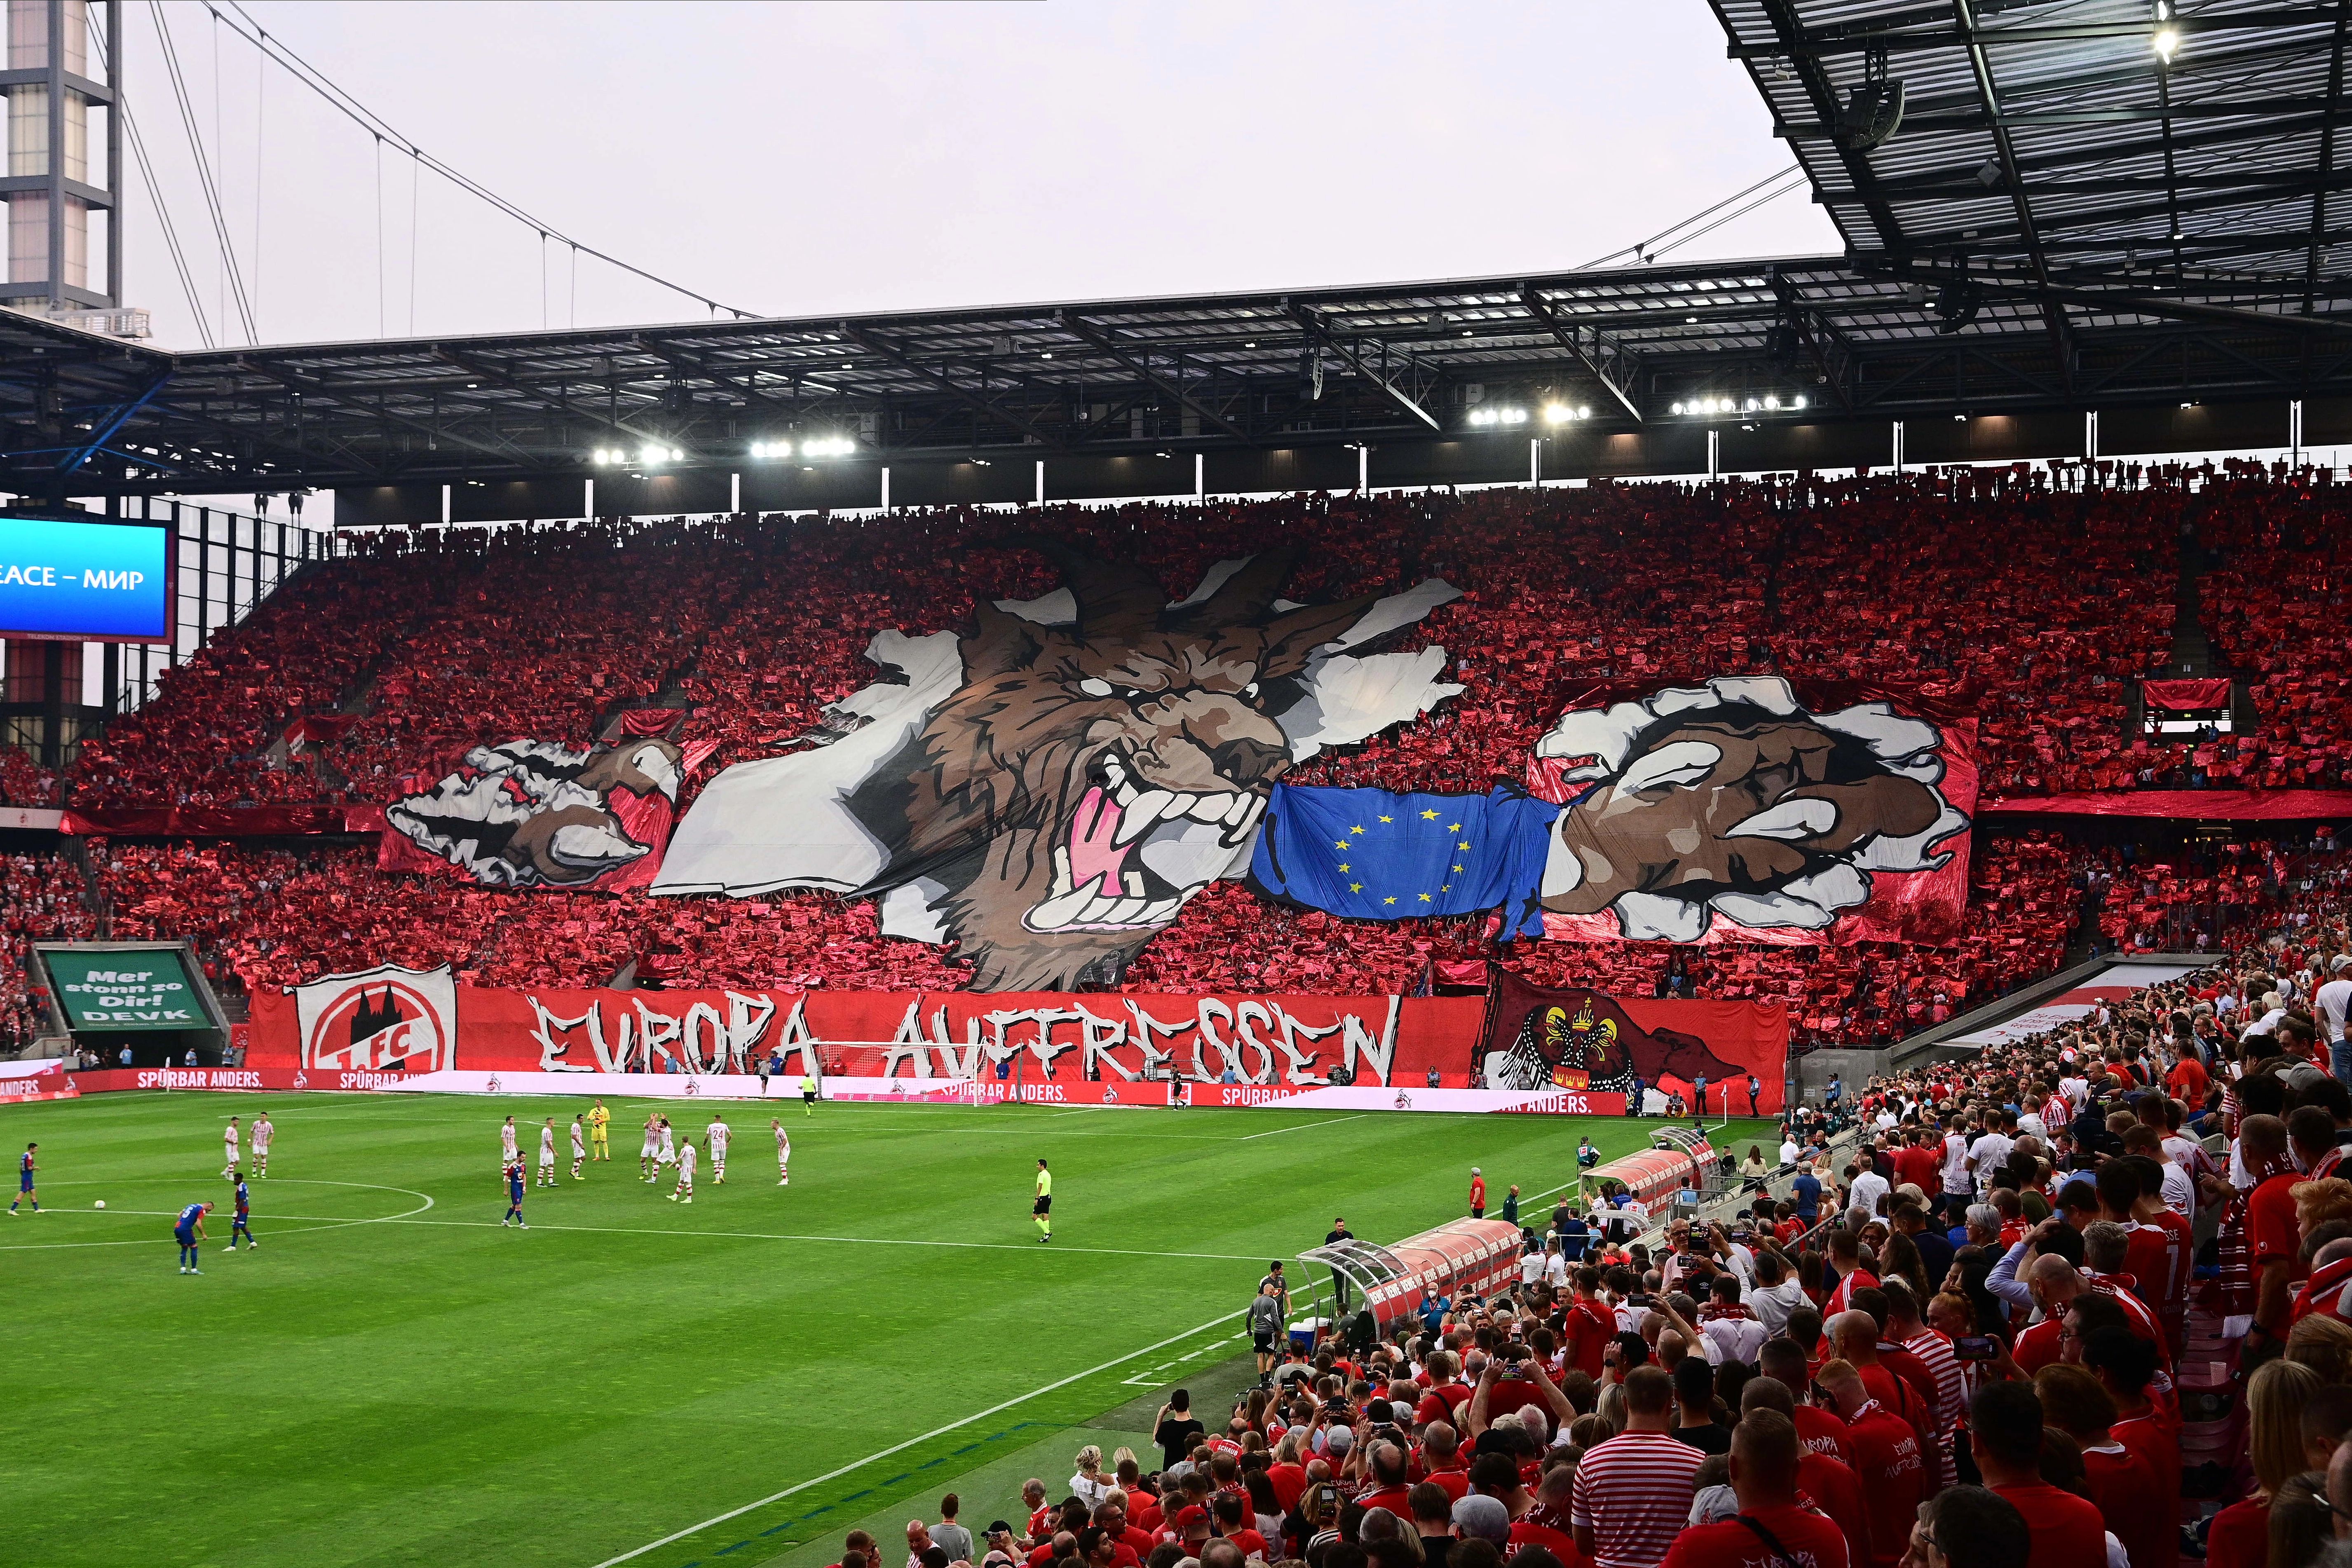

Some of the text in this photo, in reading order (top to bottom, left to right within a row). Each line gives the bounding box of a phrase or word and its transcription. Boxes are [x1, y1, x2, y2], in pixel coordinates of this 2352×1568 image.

[83, 569, 144, 590] МИР
[87, 970, 153, 983] Mer
[65, 982, 183, 994] stonn zo
[98, 995, 163, 1007] Dir!
[82, 1009, 191, 1021] DEVK
[138, 1069, 263, 1088] SPÜRBAR ANDERS.
[0, 1079, 41, 1096] ANDERS.
[1009, 1083, 1067, 1101] ANDERS.
[713, 1130, 723, 1140] 24
[2175, 1151, 2185, 1161] UTH
[1498, 1237, 1511, 1251] REWE
[1509, 1232, 1522, 1246] REWE
[1462, 1251, 1476, 1266] REWE
[1475, 1247, 1489, 1261] REWE
[1422, 1268, 1438, 1284] REWE
[1436, 1262, 1451, 1278] REWE
[1502, 1265, 1512, 1280] REWE
[1384, 1282, 1402, 1299] REWE
[1400, 1276, 1417, 1293] REWE
[1478, 1276, 1489, 1291] REWE
[1368, 1288, 1386, 1305] REWE
[1217, 1444, 1238, 1456] SCHAUB
